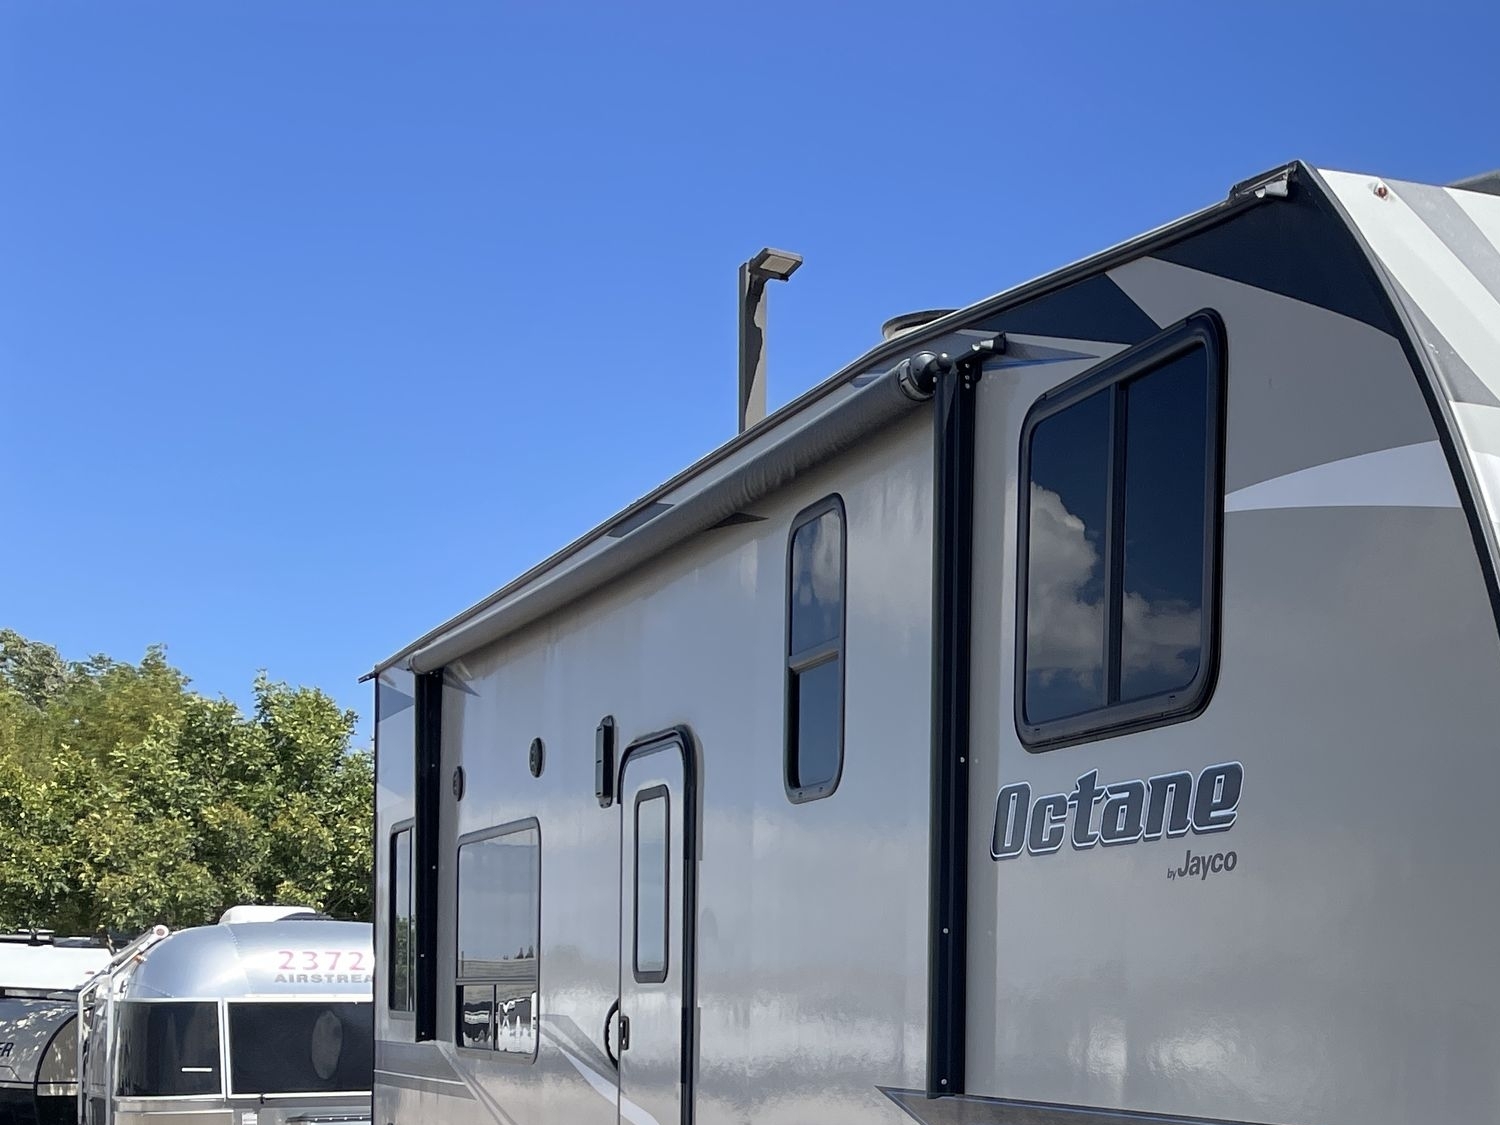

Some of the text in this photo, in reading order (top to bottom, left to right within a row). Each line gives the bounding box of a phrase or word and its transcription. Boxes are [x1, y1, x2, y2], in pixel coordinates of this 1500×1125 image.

[990, 761, 1244, 861] Octane
[1166, 850, 1238, 880] by Jayco
[278, 950, 367, 971] 2372
